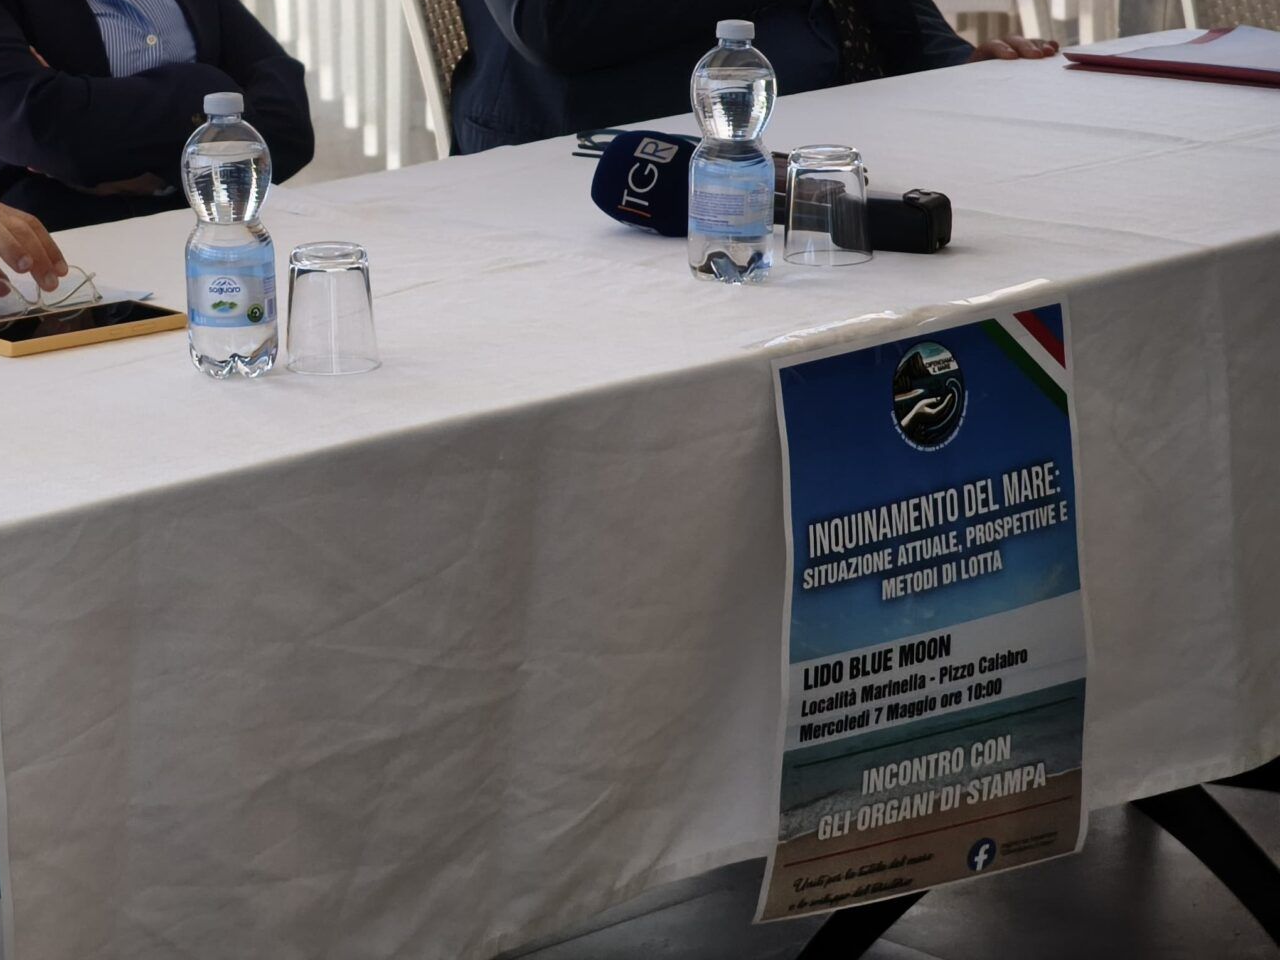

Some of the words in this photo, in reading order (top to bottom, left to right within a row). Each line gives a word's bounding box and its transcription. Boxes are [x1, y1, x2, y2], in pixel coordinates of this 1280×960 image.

[208, 286, 241, 295] saguaro
[808, 488, 959, 559] INQUINAMENTO
[963, 478, 998, 518] DEL
[1002, 461, 1061, 508] MARE:
[802, 549, 893, 590] SITUAZIONE
[897, 531, 963, 567] ATTUALE,
[965, 503, 1057, 548] PROSPETTIVE
[1060, 500, 1068, 521] E
[881, 570, 938, 602] METODI
[942, 562, 957, 585] DI
[960, 549, 1003, 579] LOTTA
[801, 688, 857, 718] Località
[860, 672, 927, 703] Marinella
[939, 661, 975, 685] Pizzo
[978, 647, 1028, 675] Calabro
[803, 666, 844, 691] LIDO
[849, 648, 893, 681] BLUE
[898, 634, 952, 668] MOON
[799, 709, 871, 742] Mercoledì
[874, 706, 883, 725] 7
[886, 695, 937, 722] Maggio
[940, 690, 962, 709] ore
[967, 678, 1002, 703] 10:00
[862, 747, 964, 795] INCONTRO
[970, 735, 1012, 768] CON
[818, 811, 850, 841] GLI
[856, 788, 934, 832] ORGANI
[939, 782, 960, 810] DI
[966, 762, 1047, 806] STAMPA
